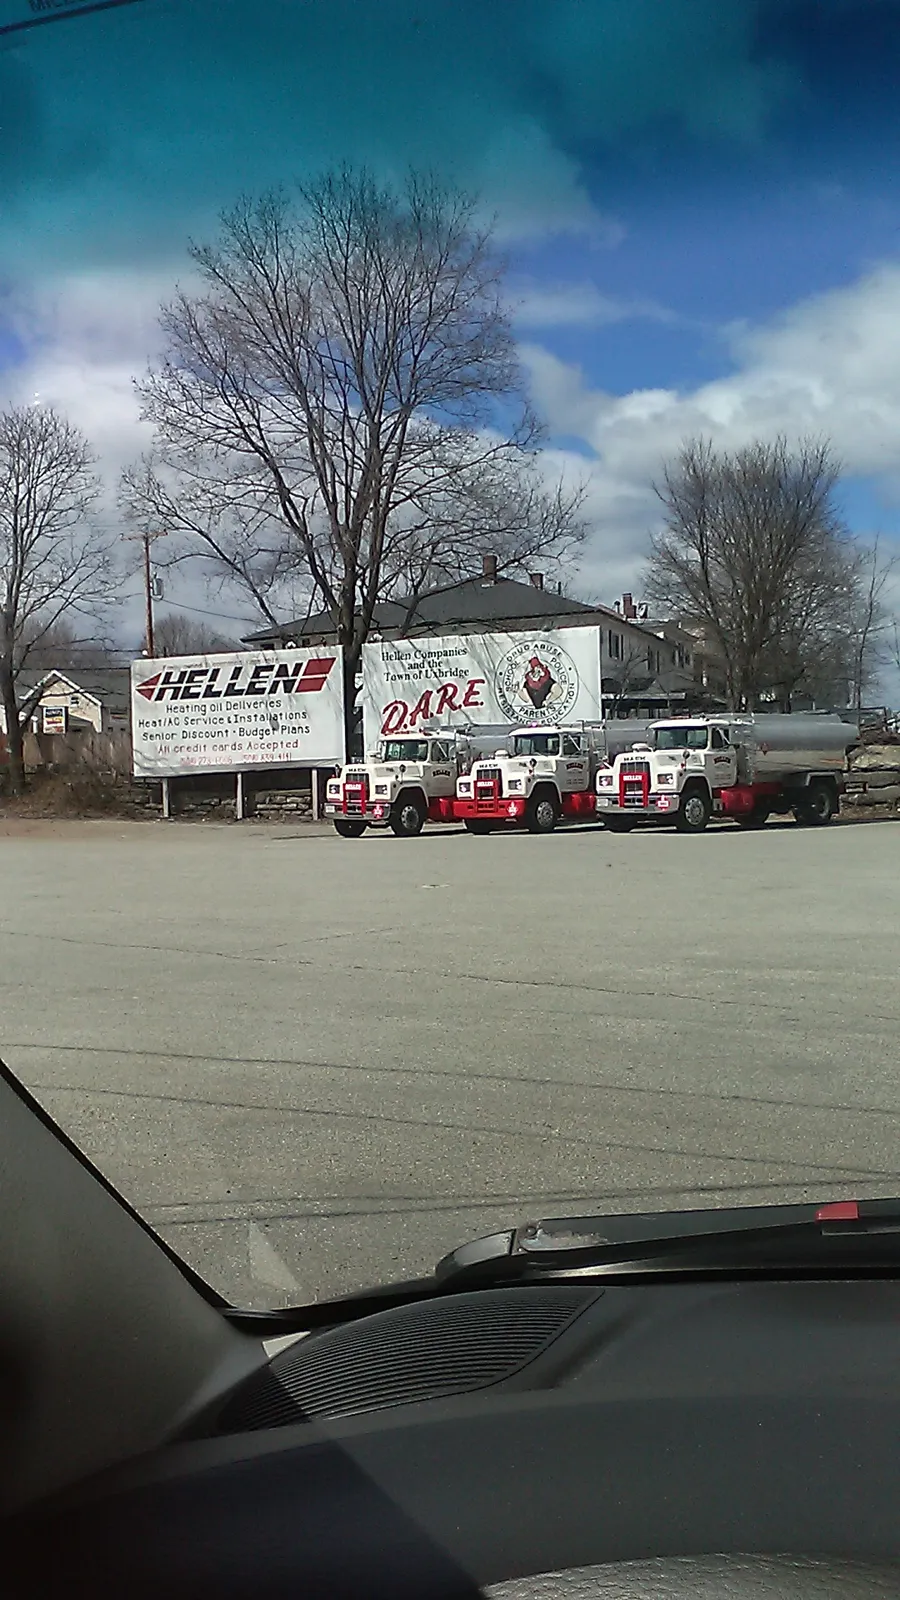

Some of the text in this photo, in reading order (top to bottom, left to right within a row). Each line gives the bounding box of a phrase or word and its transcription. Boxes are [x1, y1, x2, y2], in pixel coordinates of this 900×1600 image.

[382, 647, 468, 661] Hellen Companies
[506, 643, 563, 662] DRUG ABUSE
[407, 659, 443, 670] and the
[550, 657, 567, 685] POLICE
[155, 662, 303, 702] HELLEN
[384, 668, 470, 681] Town of Uxbridge
[504, 660, 520, 692] SCHOOL
[166, 704, 207, 716] Heating
[226, 699, 282, 711] Deliveries
[381, 679, 485, 735] D.A.R.E.
[519, 704, 556, 718] PARENTS
[138, 717, 180, 728] Heat/AC
[184, 716, 224, 726] Service
[233, 711, 307, 723] Installations
[142, 725, 310, 741] Senior Discount Budget Plans
[158, 739, 299, 754] All credit cards Accepted
